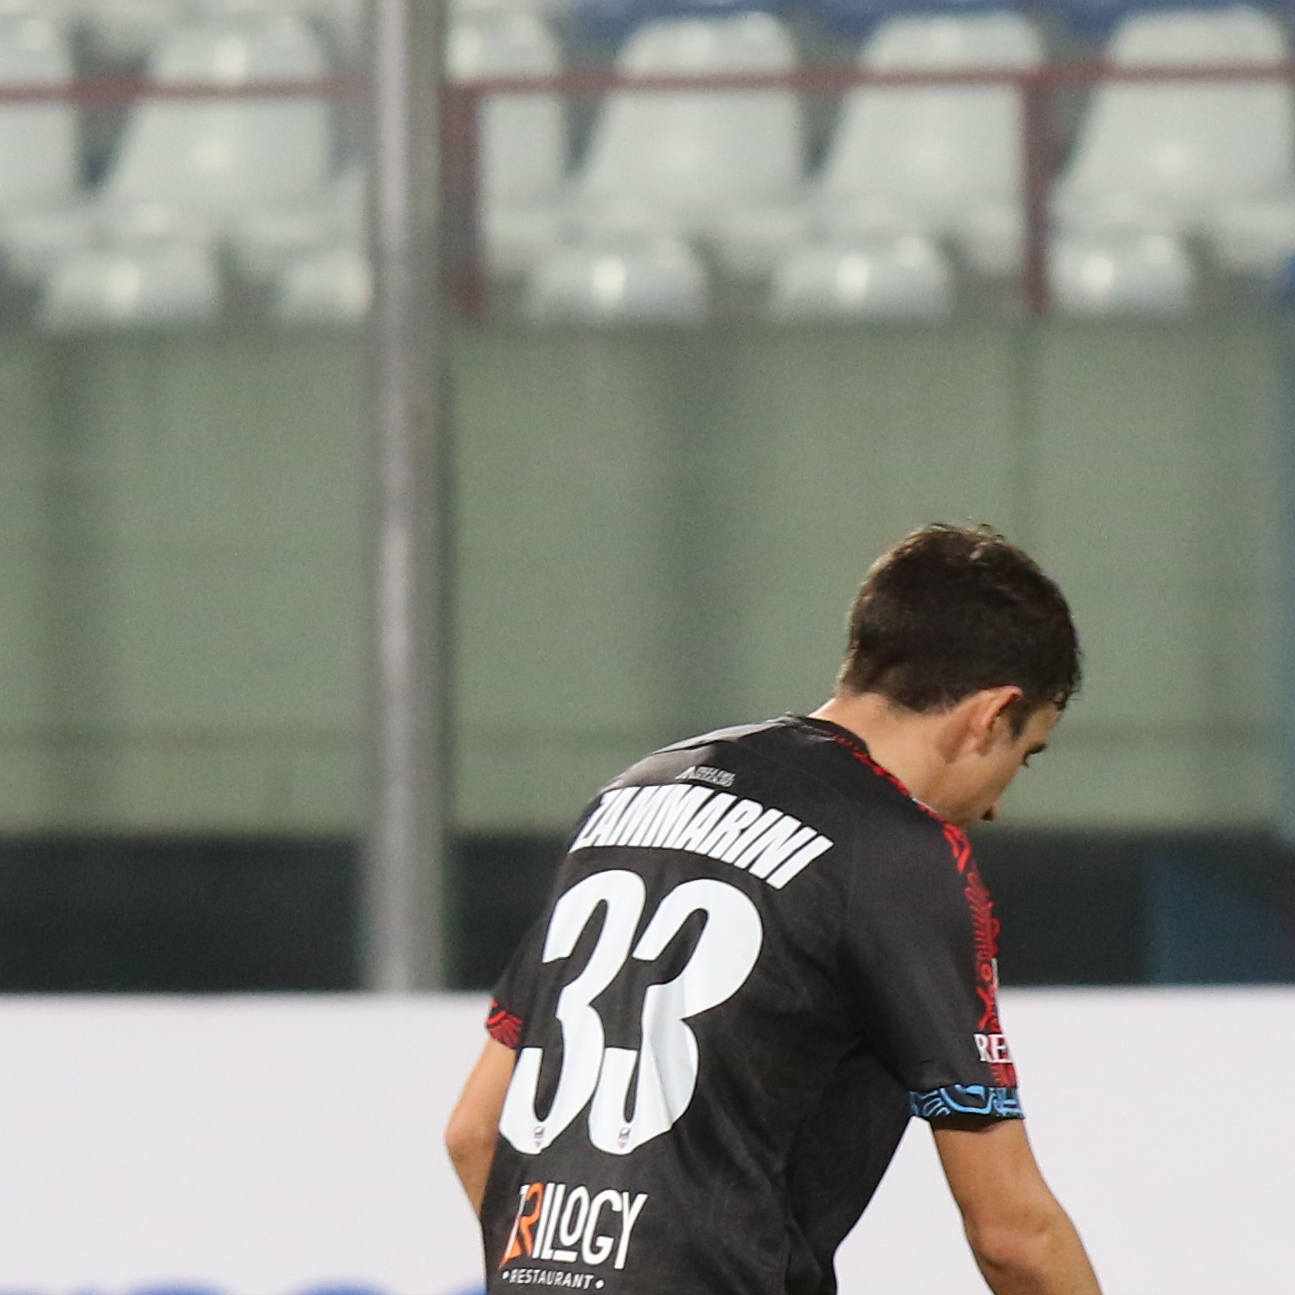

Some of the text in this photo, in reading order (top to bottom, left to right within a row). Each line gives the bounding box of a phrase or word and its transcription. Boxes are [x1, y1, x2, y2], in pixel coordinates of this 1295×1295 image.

[499, 868, 764, 1155] 33
[499, 1182, 648, 1269] TRILOGY
[508, 1269, 595, 1289] RESTAURANT
